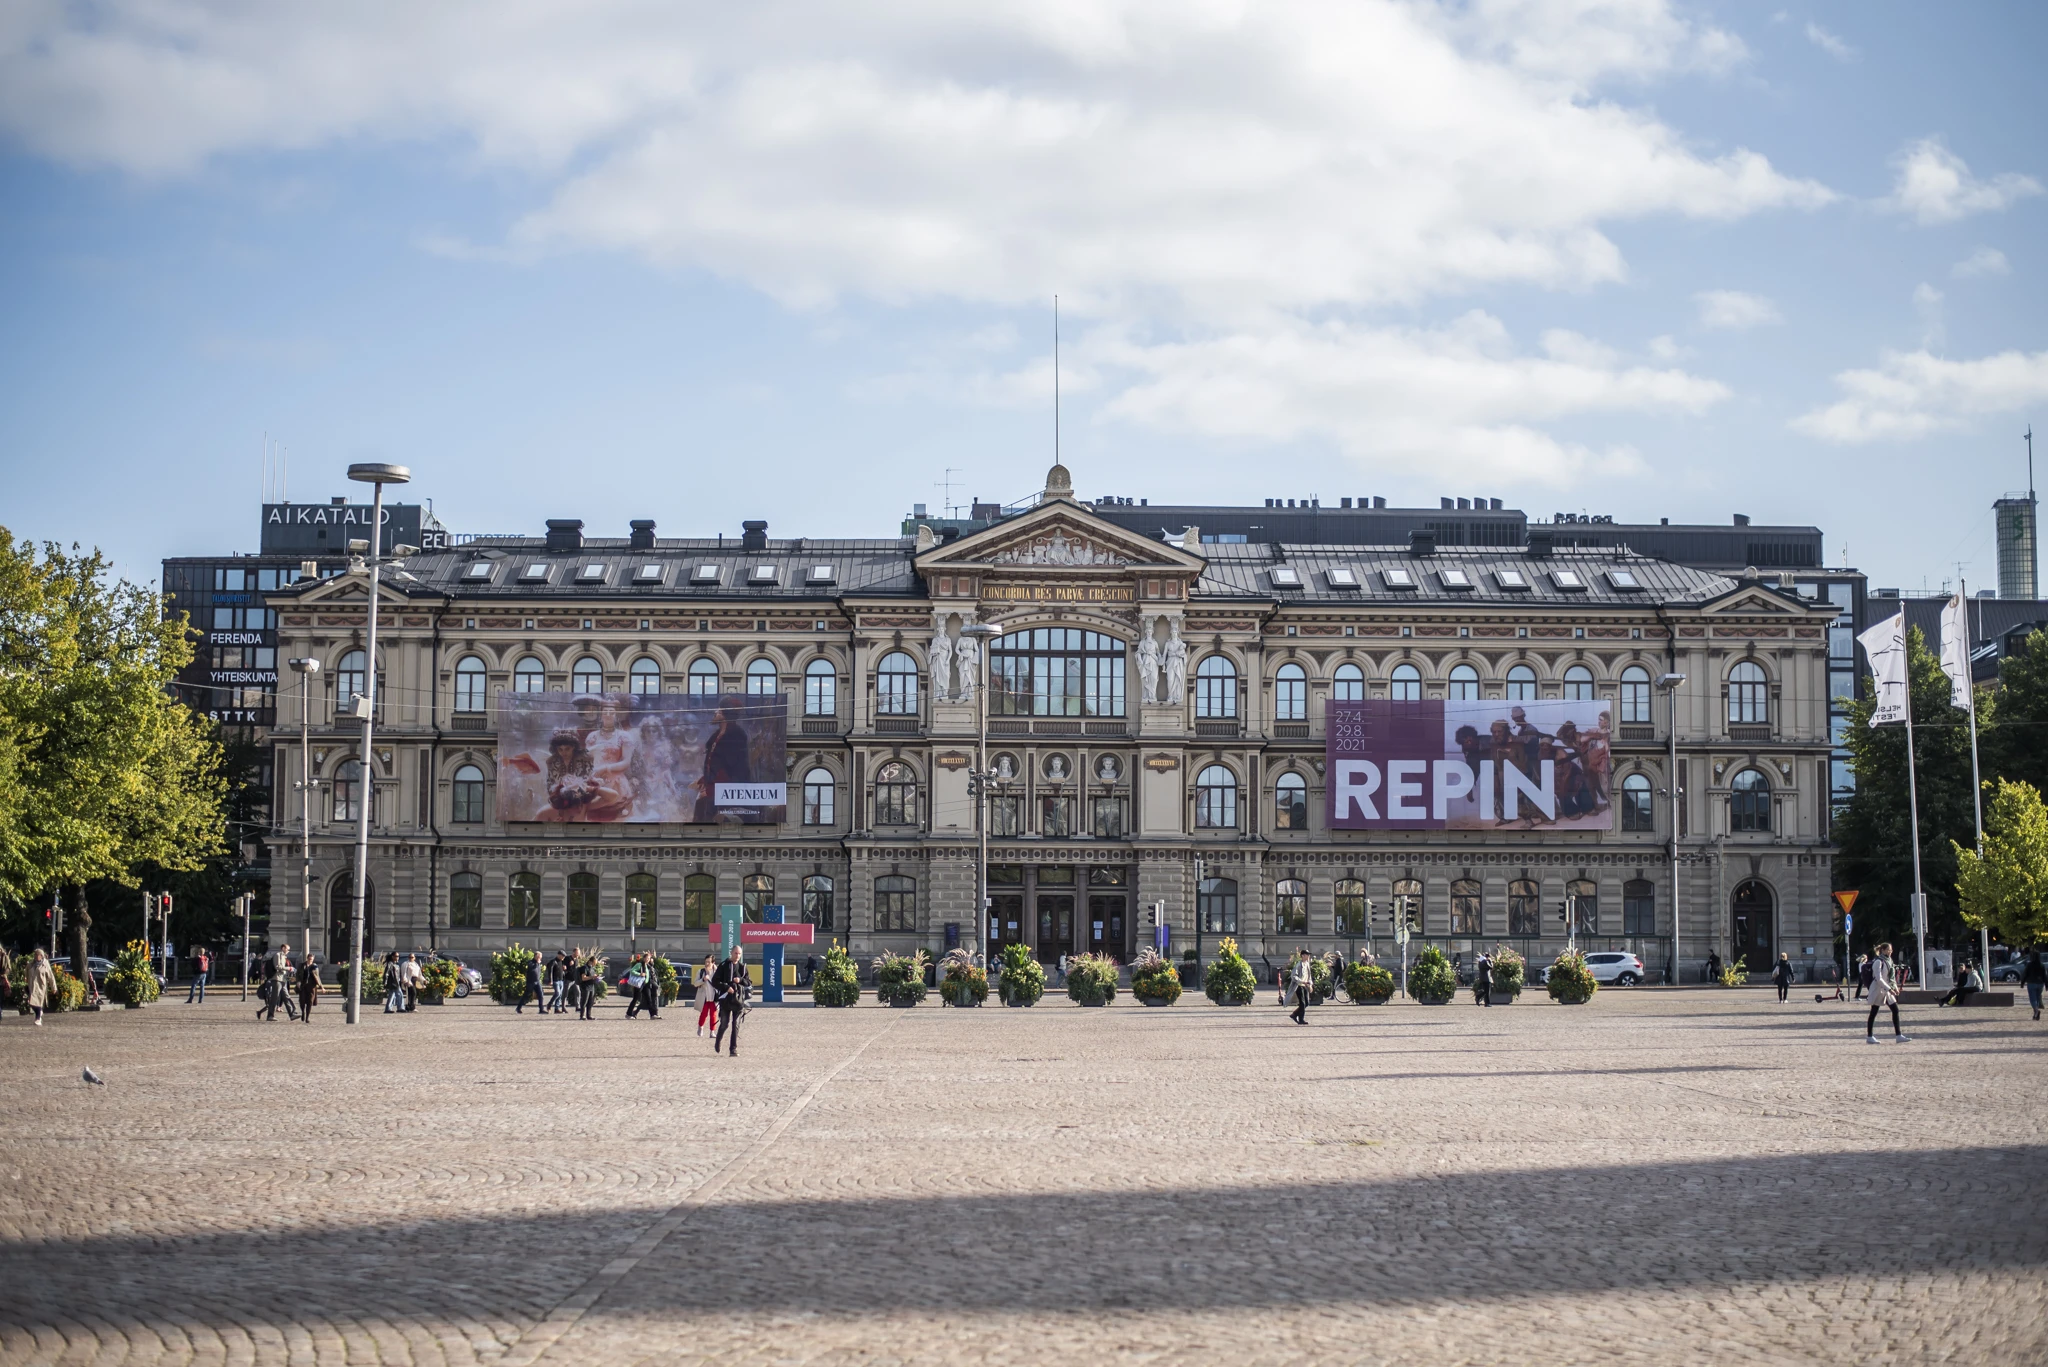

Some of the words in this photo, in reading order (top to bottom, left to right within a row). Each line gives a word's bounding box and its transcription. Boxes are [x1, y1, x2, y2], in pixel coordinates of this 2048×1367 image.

[983, 586, 1031, 599] CONCORDIA
[1034, 587, 1052, 600] RES
[1089, 588, 1134, 601] CRESCUNT
[210, 633, 262, 644] FERENDA
[1335, 710, 1365, 723] 27.4.
[1335, 724, 1365, 737] 29.8.
[1335, 738, 1365, 751] 2021
[721, 788, 779, 800] ATENEUM
[1335, 759, 1555, 821] REPIN
